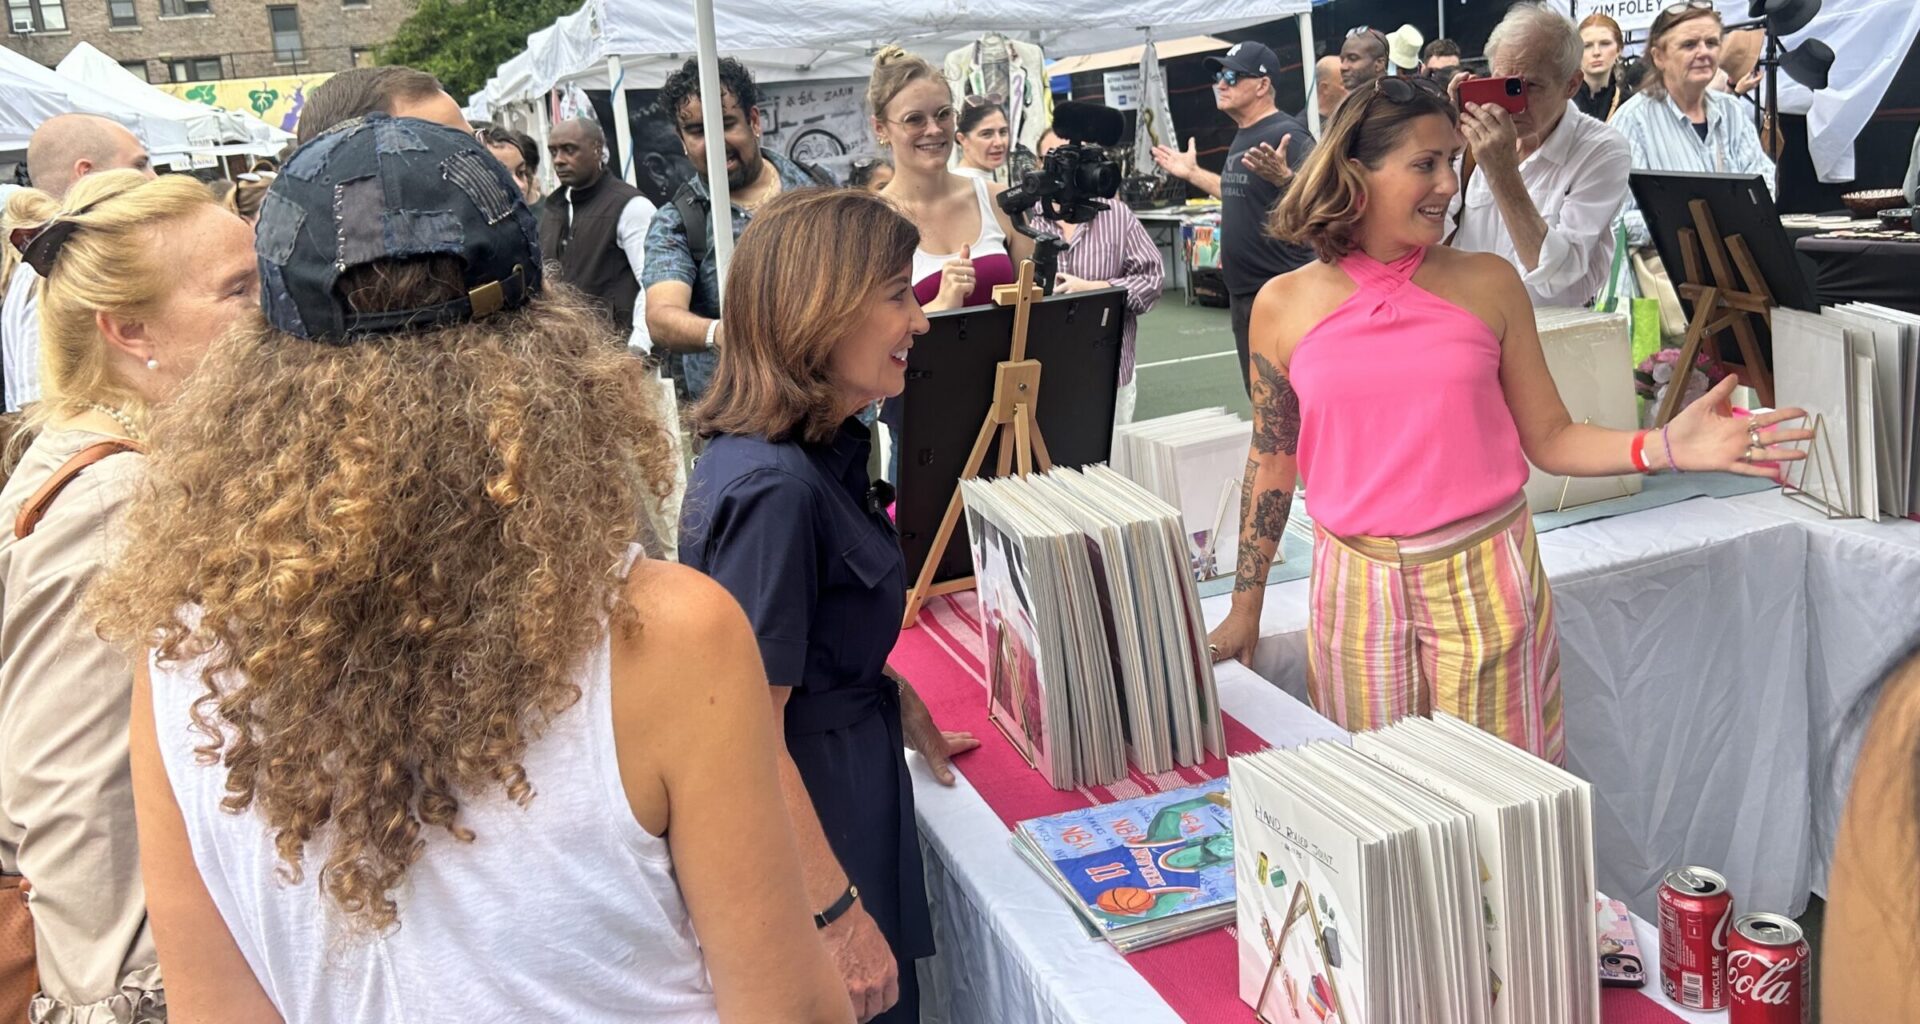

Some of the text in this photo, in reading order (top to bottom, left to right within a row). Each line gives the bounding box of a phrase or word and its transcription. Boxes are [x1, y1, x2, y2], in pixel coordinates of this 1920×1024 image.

[1618, 0, 1663, 16] FOLEY
[1254, 801, 1281, 831] HAND
[1085, 862, 1131, 883] 11
[1711, 955, 1720, 968] ME
[1711, 970, 1721, 1008] RECYCLE
[1727, 950, 1797, 1006] Cola
